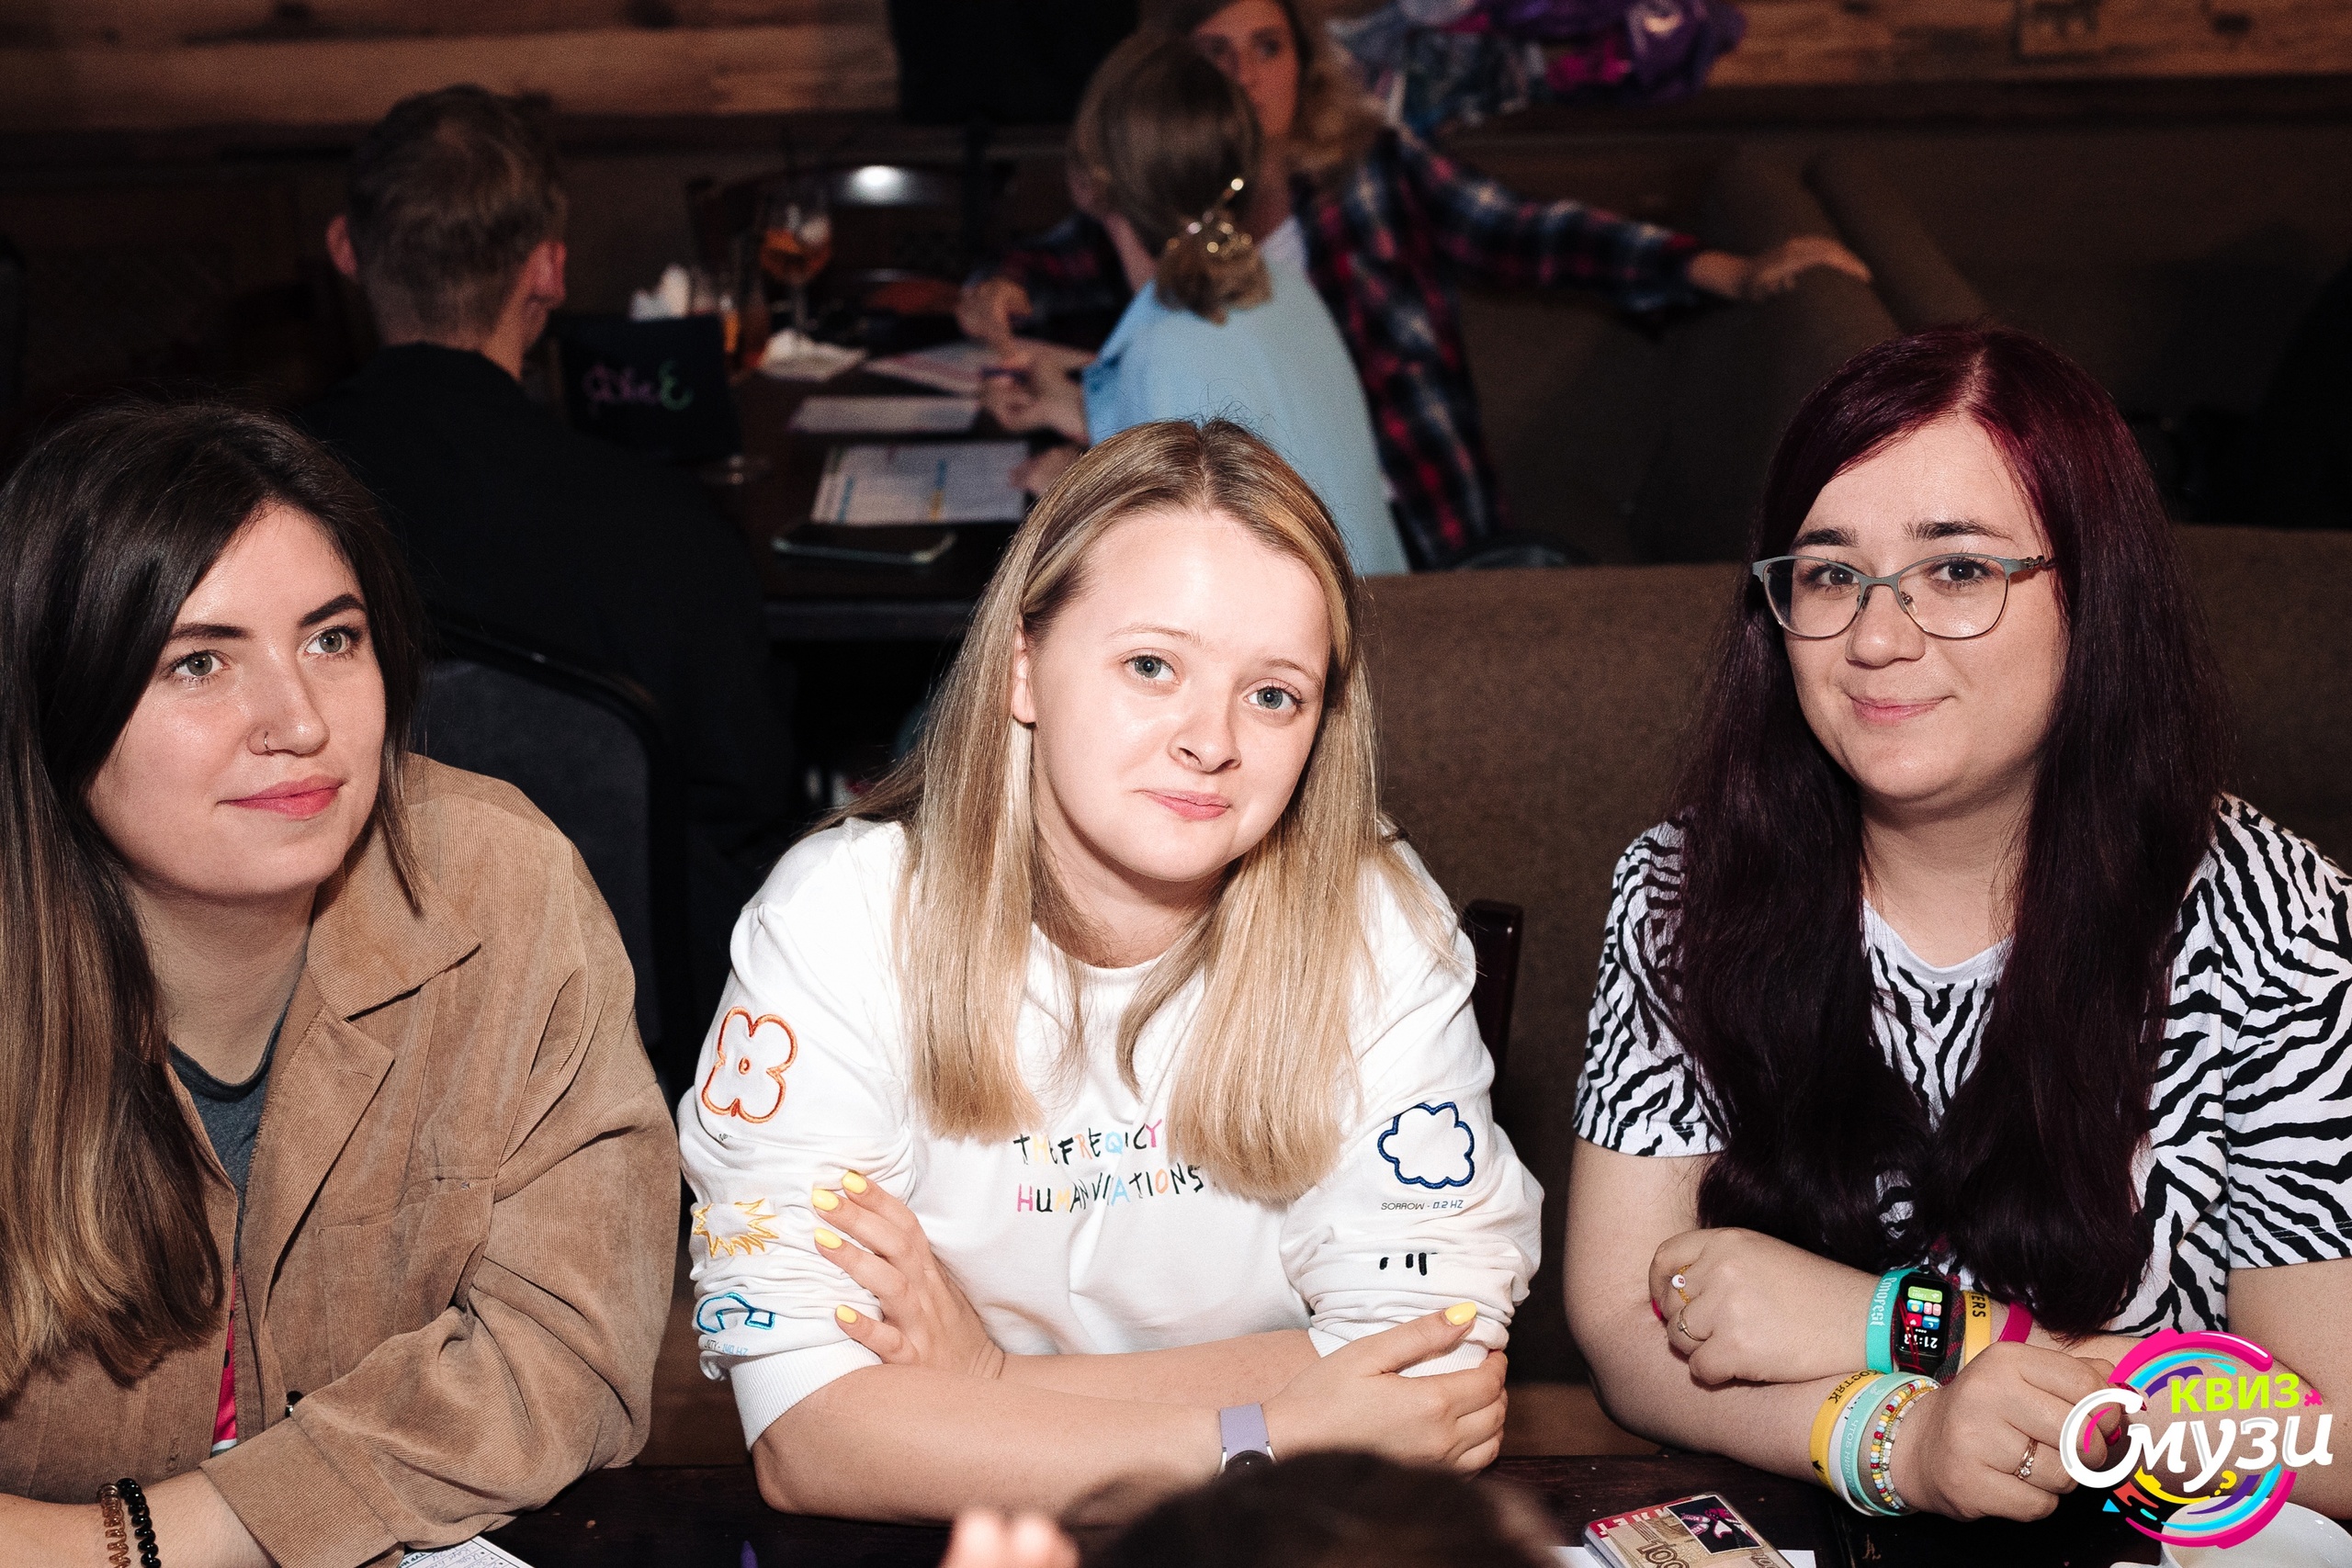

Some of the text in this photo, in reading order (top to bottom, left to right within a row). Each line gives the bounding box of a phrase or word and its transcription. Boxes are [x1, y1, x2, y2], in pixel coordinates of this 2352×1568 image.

[1381, 1201, 1425, 1211] SORROW
[1432, 1201, 1449, 1209] 0.2
[1450, 1199, 1464, 1209] HZ
